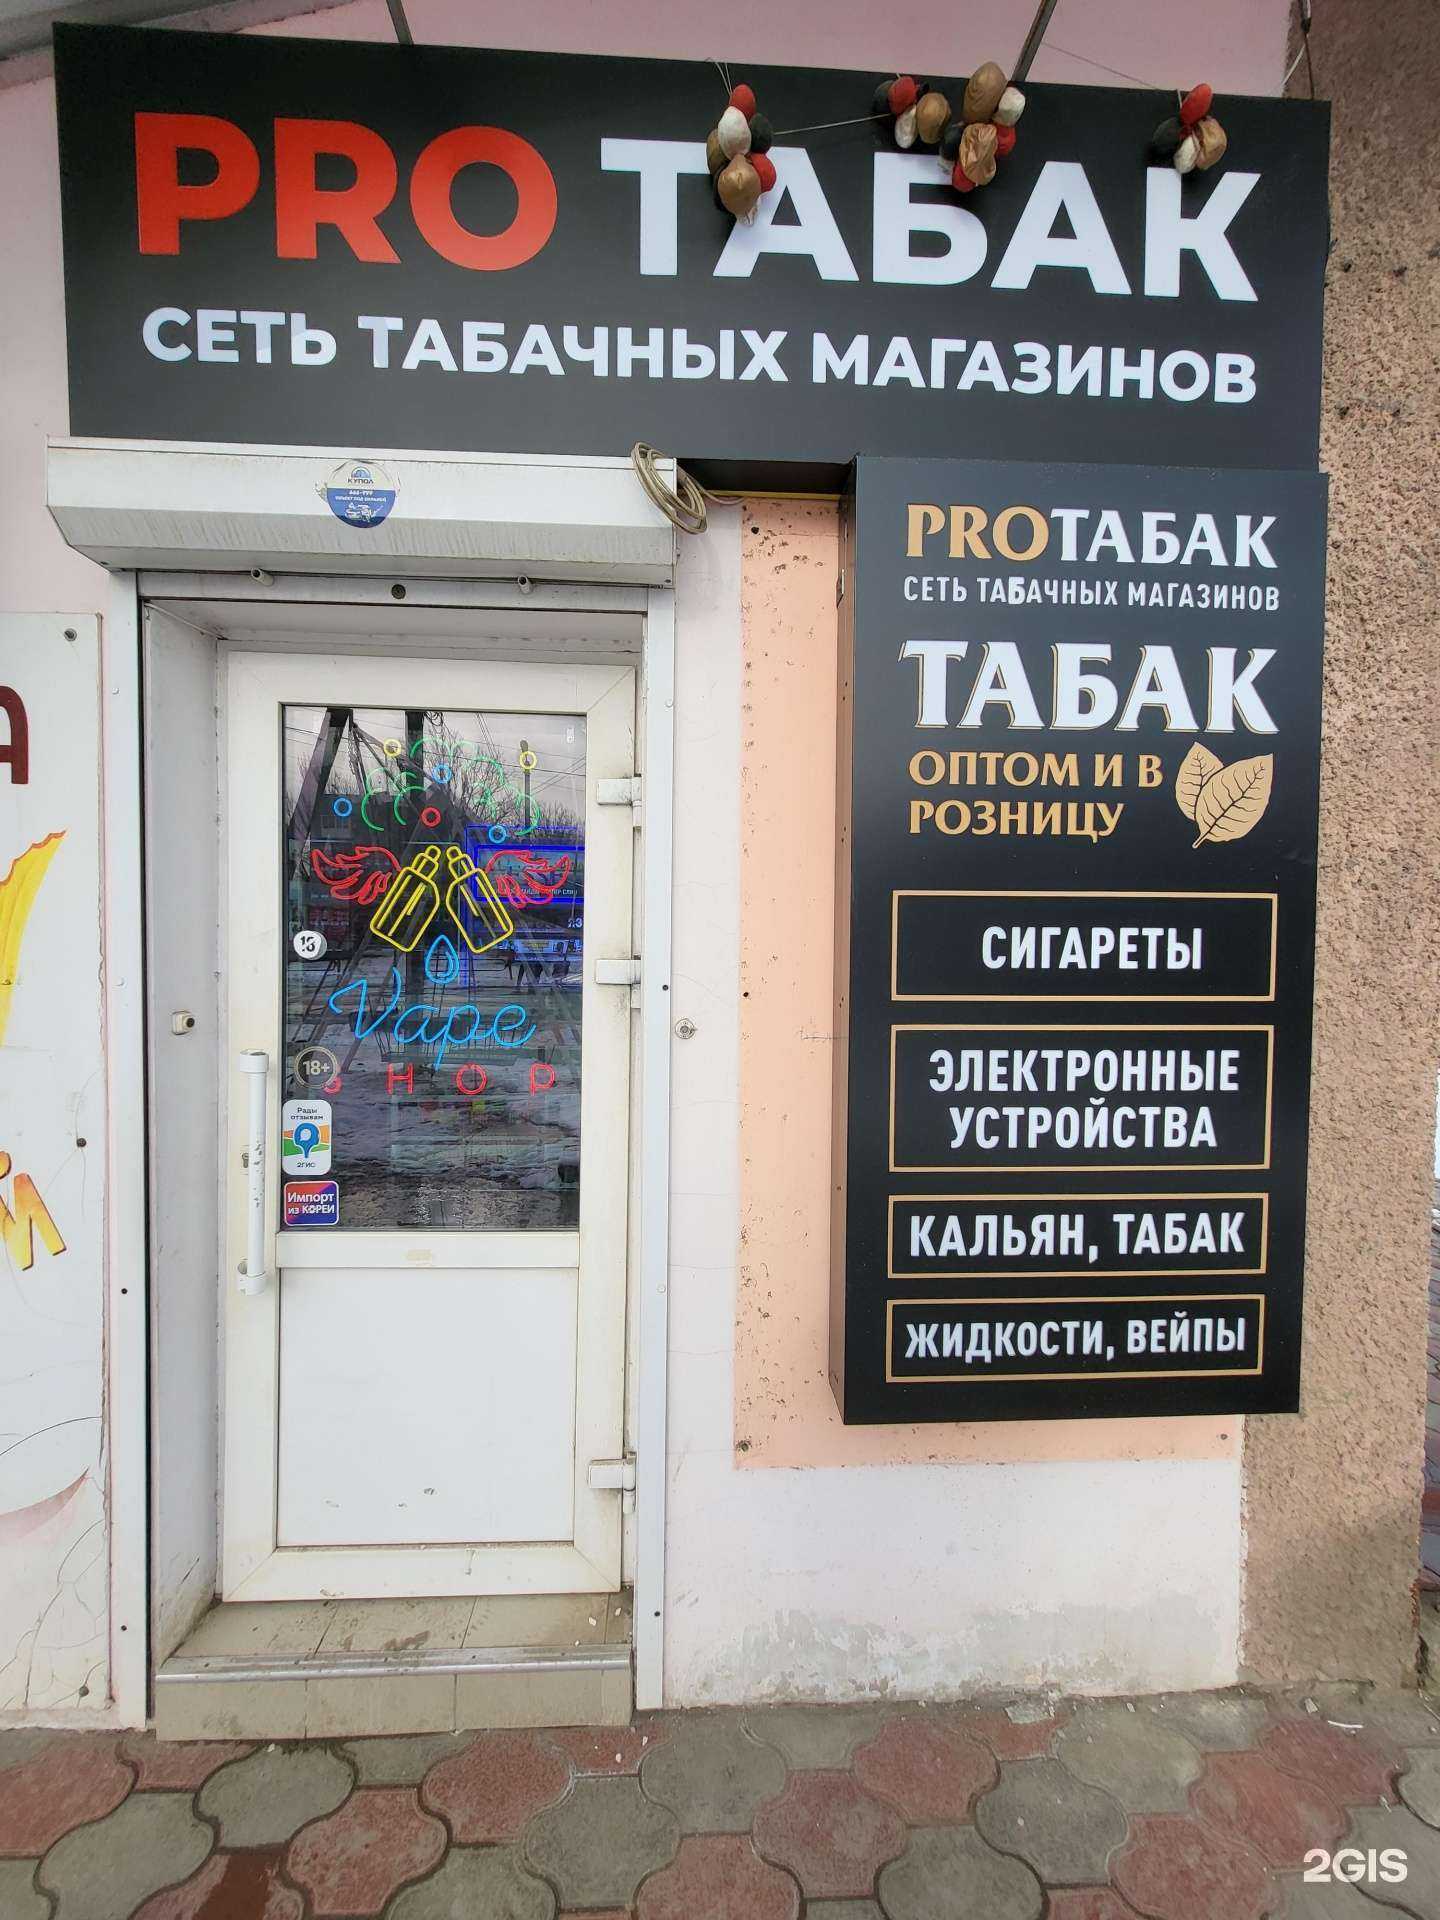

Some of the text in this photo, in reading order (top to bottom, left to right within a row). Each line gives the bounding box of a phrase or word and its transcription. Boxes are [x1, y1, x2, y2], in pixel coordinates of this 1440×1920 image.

[134, 112, 1261, 302] PRO ТАБАК
[142, 307, 1257, 403] СЕТЬ ТАБАЧНЫХ МАГАЗИНОВ
[903, 575, 1280, 611] СЕТЬ ТАБАЧНЫХ МАГАЗИНОВ
[898, 639, 1280, 735] ТАБАК
[908, 750, 1164, 788] ОПТОМ И В
[909, 799, 1124, 844] РОЗНИЦУ
[982, 925, 1202, 970] СИГАРЕТЫ
[329, 967, 537, 1071] Vape
[302, 1060, 330, 1076] 18+
[929, 1049, 1240, 1092] ЭЛЕКТРОННЫЕ
[949, 1097, 1217, 1149] УСТРОЙСТВА
[287, 1192, 335, 1205] Импорт
[288, 1207, 300, 1215] из
[910, 1211, 1245, 1264] КАЛЬЯН, ТАБАК
[904, 1311, 1246, 1364] ЖИДКОСТИ, ВЕЙПЫ
